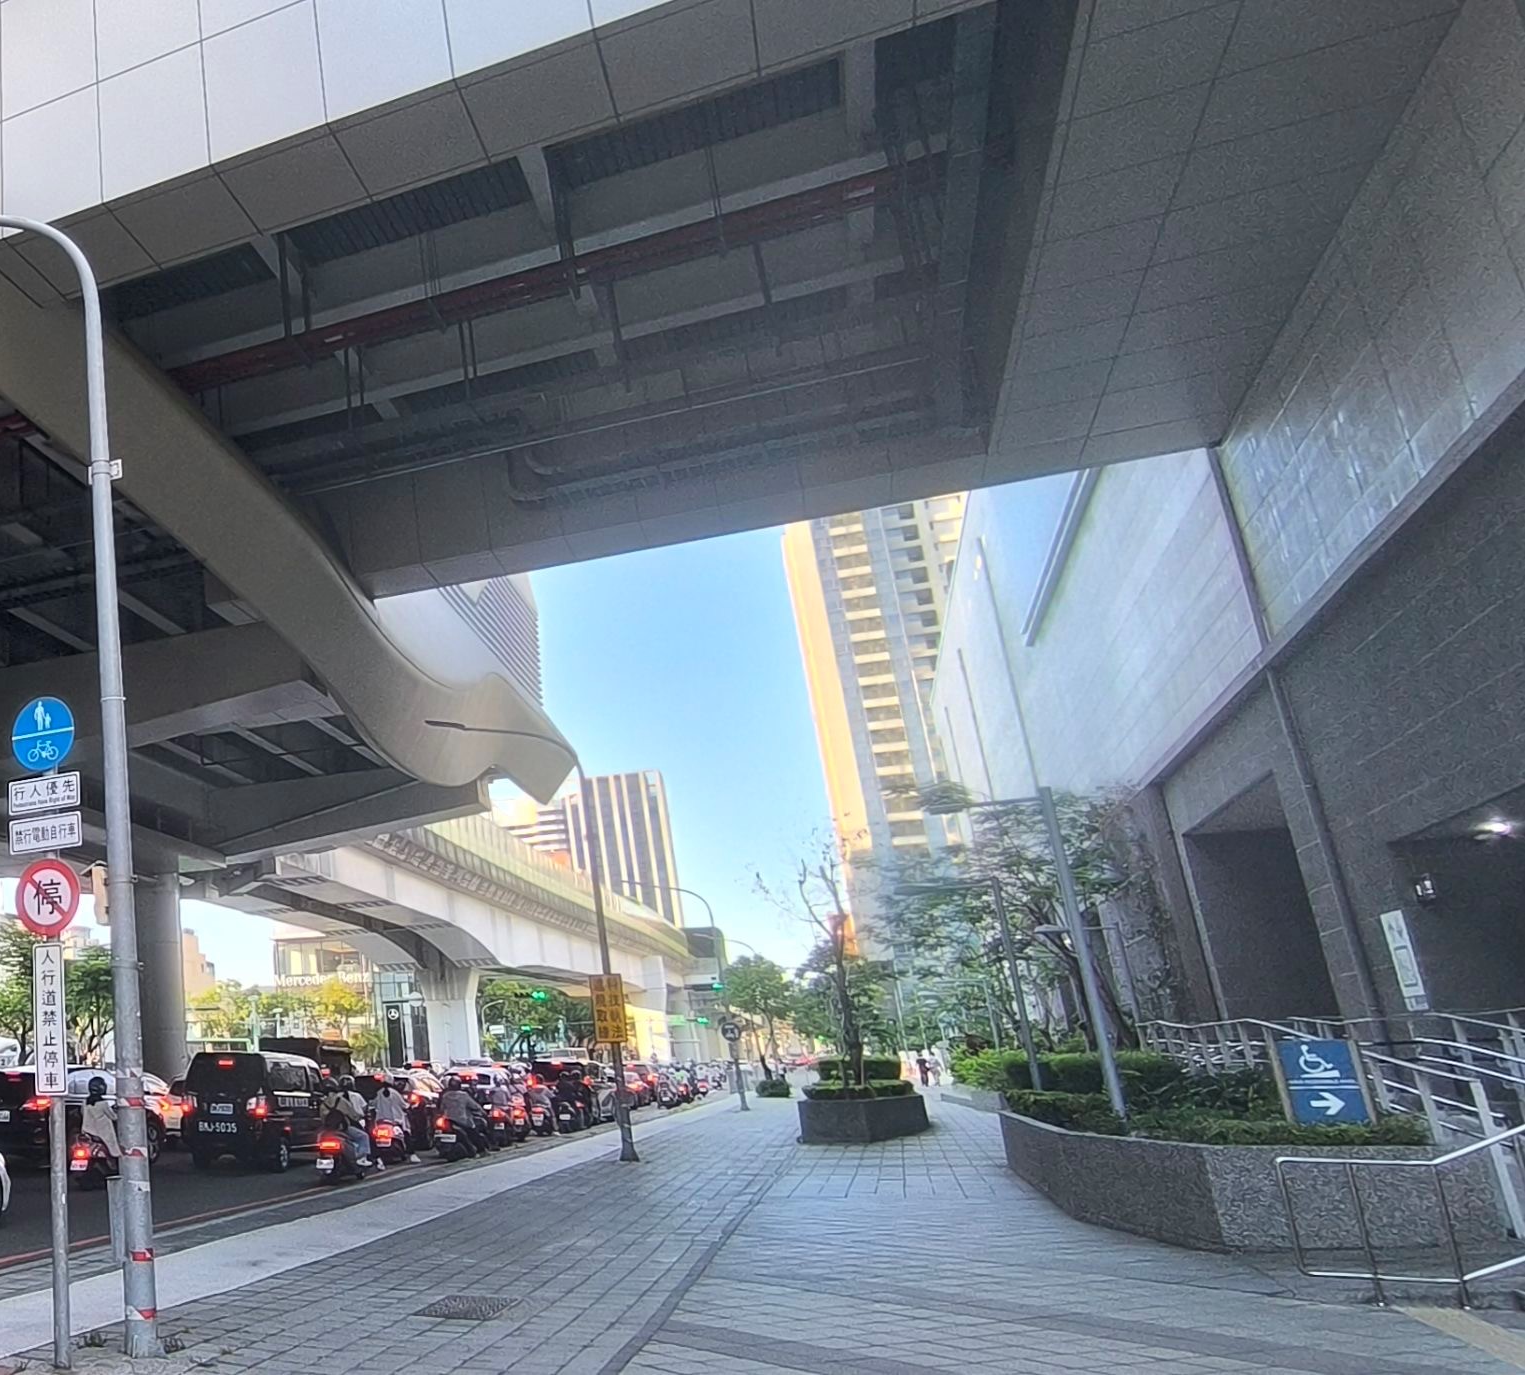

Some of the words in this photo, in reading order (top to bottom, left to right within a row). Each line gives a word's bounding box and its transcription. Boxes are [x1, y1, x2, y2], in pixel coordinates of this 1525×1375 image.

[14, 779, 75, 800] 行人優先
[15, 823, 76, 845] 禁行電動自行車
[33, 879, 62, 915] 停
[41, 949, 59, 1089] 人行道禁止停車
